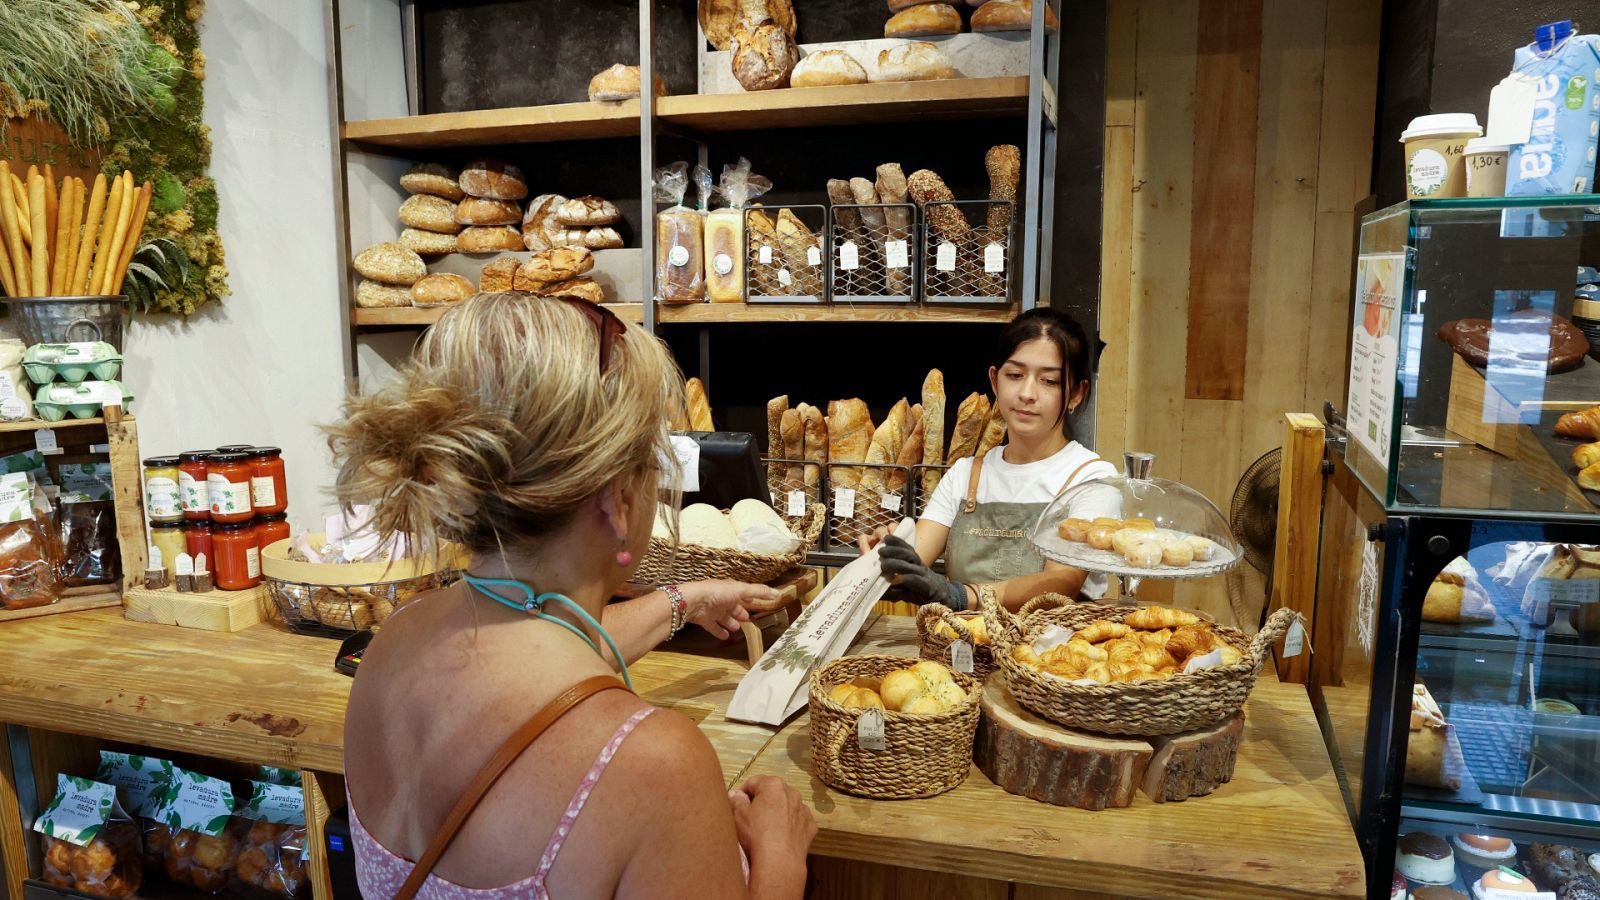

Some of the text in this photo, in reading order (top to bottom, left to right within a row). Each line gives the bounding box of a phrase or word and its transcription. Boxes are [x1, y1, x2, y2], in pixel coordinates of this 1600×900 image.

[1472, 156, 1502, 170] 1,30 €
[809, 577, 870, 641] levaduramadre
[188, 782, 219, 797] levadura
[70, 792, 98, 806] levadura
[197, 794, 218, 804] madre
[76, 803, 95, 813] madre
